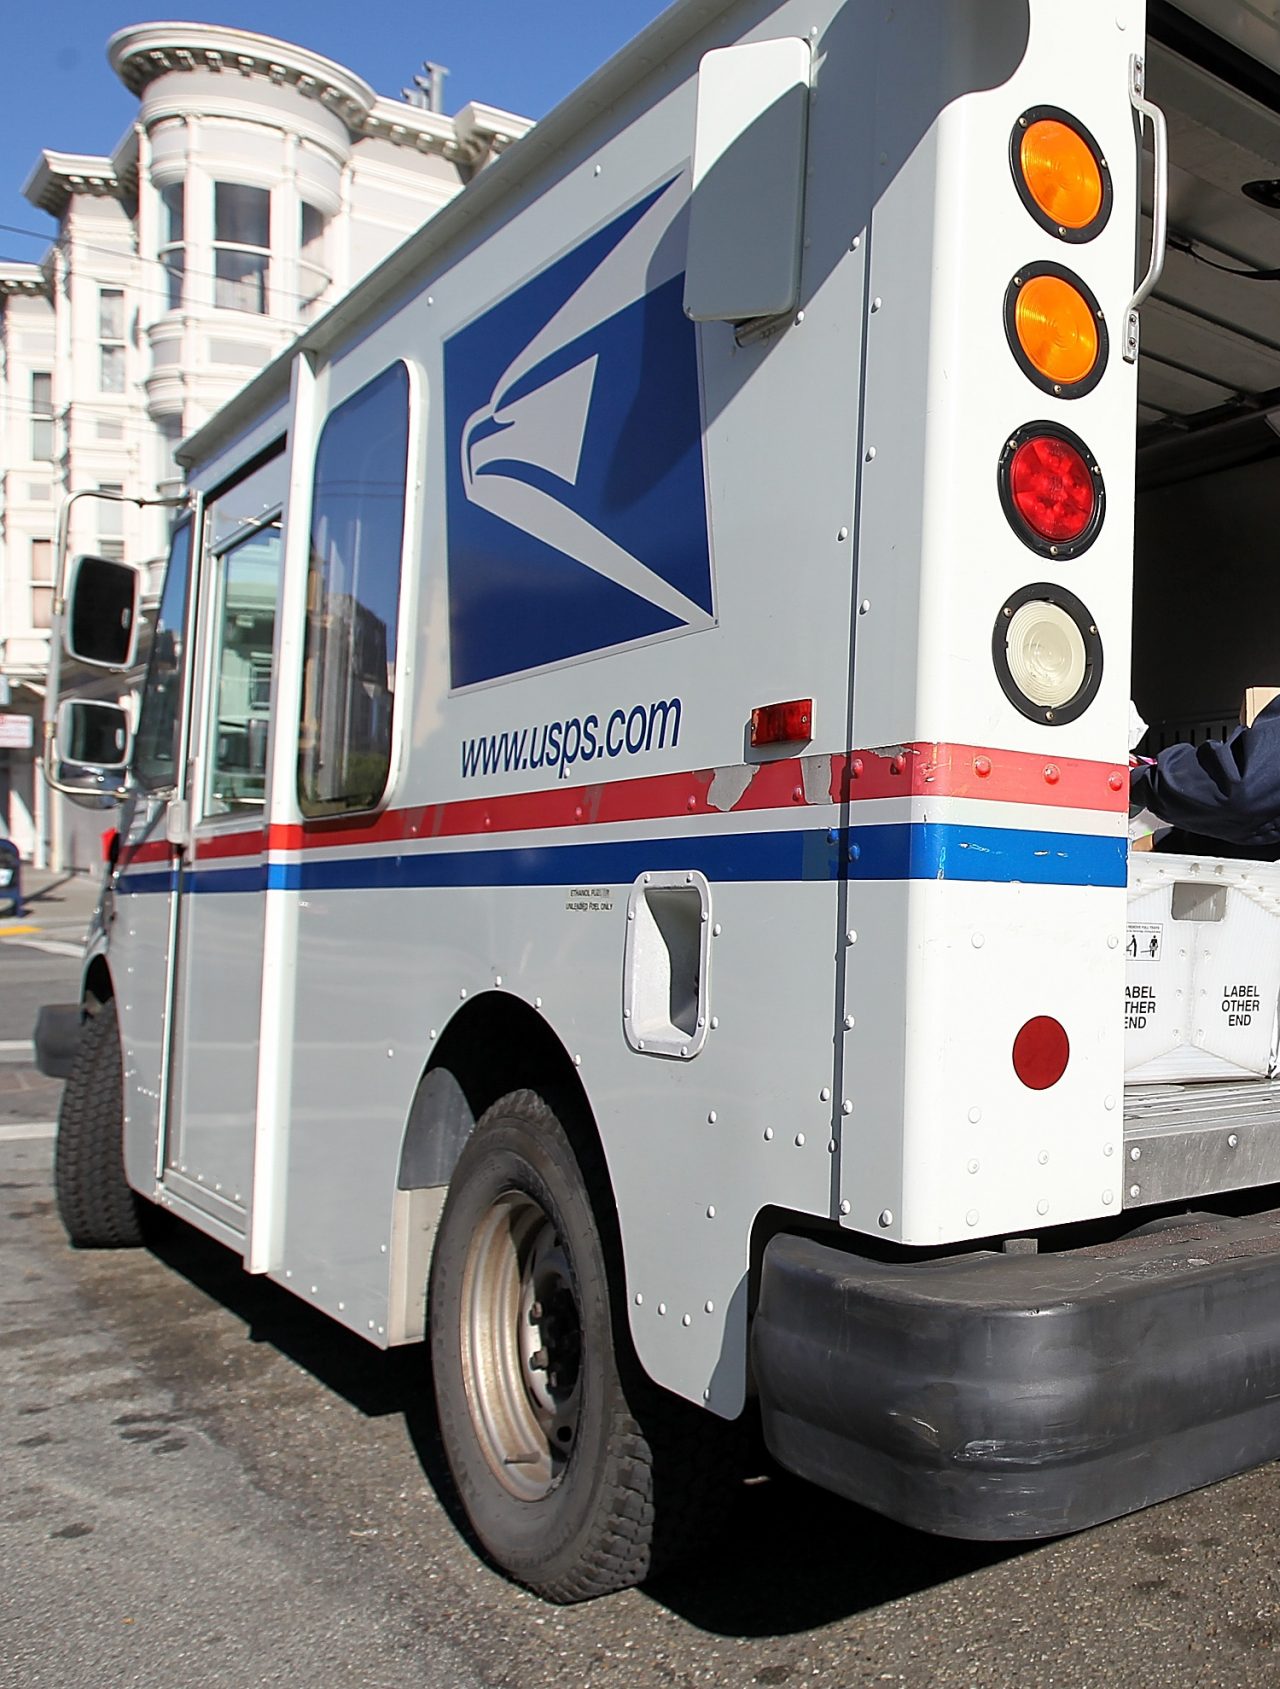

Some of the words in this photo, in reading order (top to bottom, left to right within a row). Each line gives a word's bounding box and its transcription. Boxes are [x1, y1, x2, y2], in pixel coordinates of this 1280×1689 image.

[460, 697, 682, 779] www.usps.com
[1125, 986, 1156, 999] ABEL
[1223, 985, 1260, 998] LABEL
[1125, 1001, 1156, 1014] THER
[1221, 999, 1260, 1012] OTHER
[1228, 1014, 1252, 1027] END
